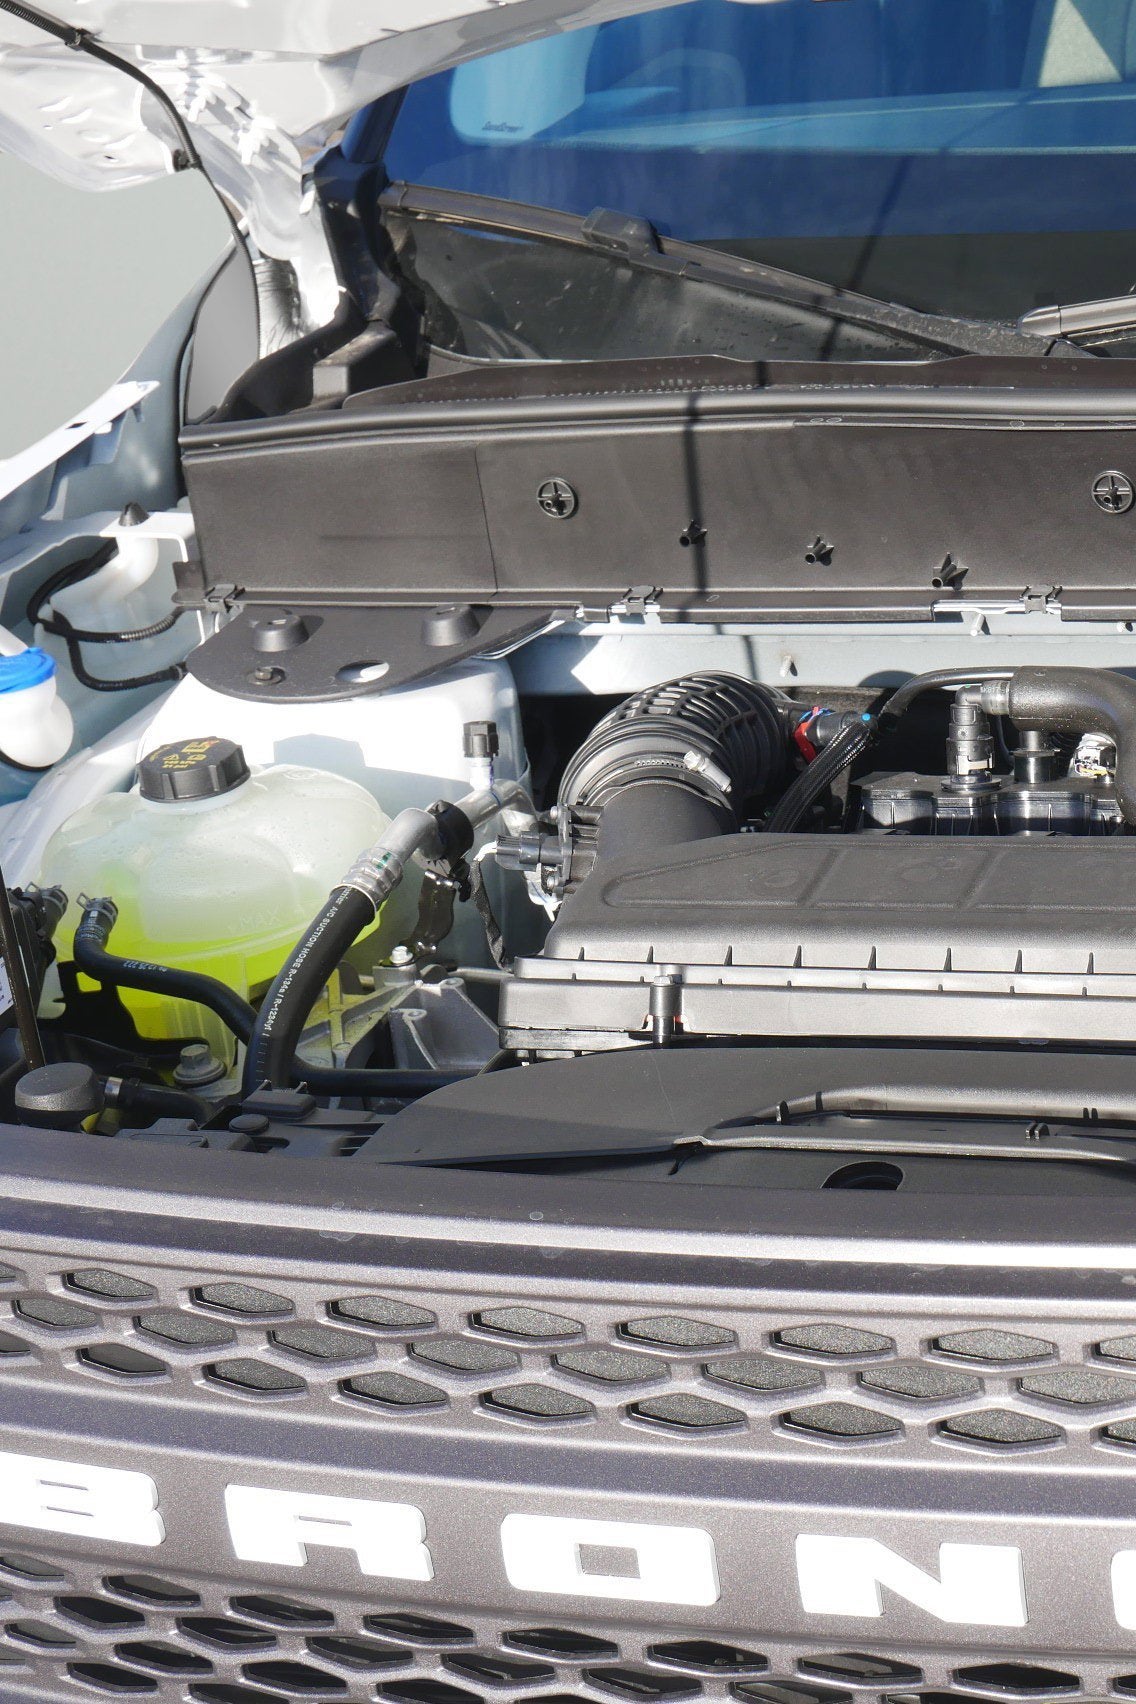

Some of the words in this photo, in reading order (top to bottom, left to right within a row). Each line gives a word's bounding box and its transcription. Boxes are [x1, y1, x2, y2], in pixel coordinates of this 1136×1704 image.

[305, 918, 330, 948] SUCTION
[292, 947, 310, 968] HOSE
[264, 998, 283, 1031] R-1234yf
